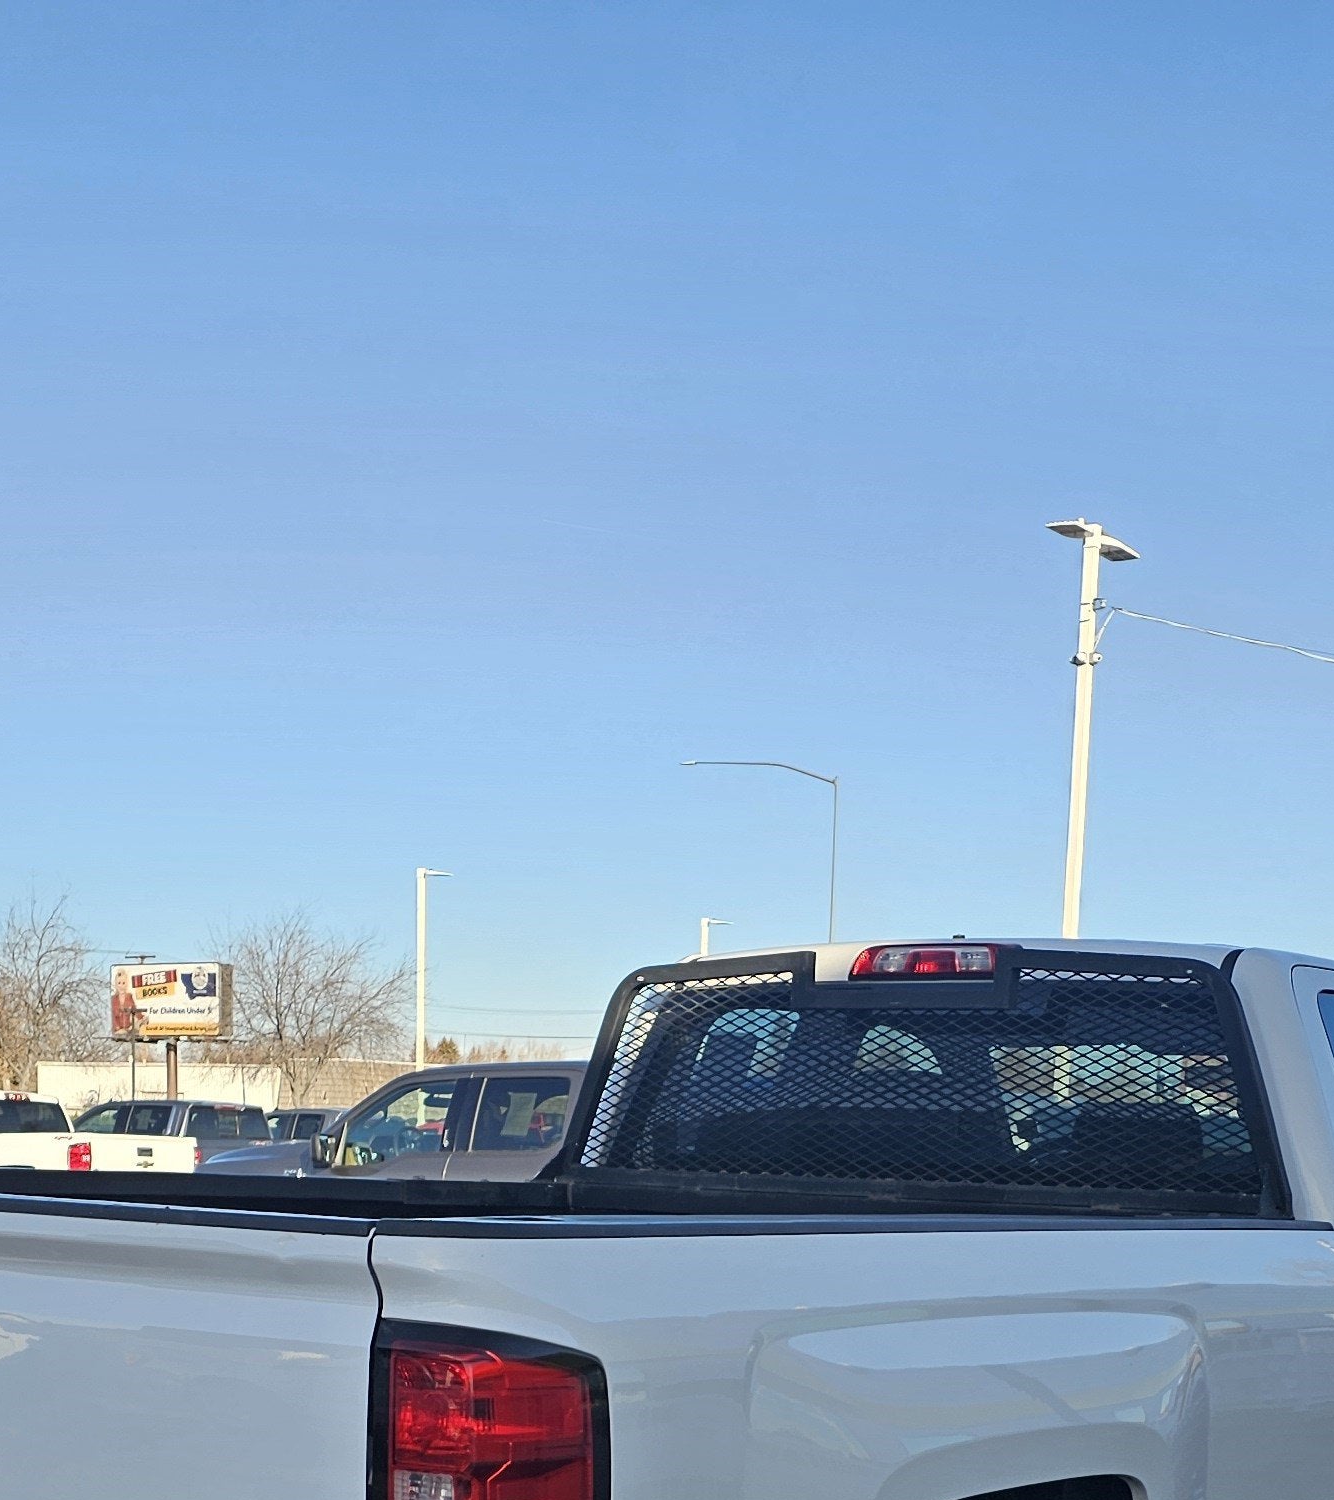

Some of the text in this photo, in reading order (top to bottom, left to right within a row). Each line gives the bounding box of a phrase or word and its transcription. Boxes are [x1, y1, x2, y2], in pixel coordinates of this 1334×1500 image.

[141, 972, 167, 987] FREE
[142, 987, 168, 998] BOOKS
[161, 1005, 186, 1014] Children
[187, 1006, 206, 1014] Under
